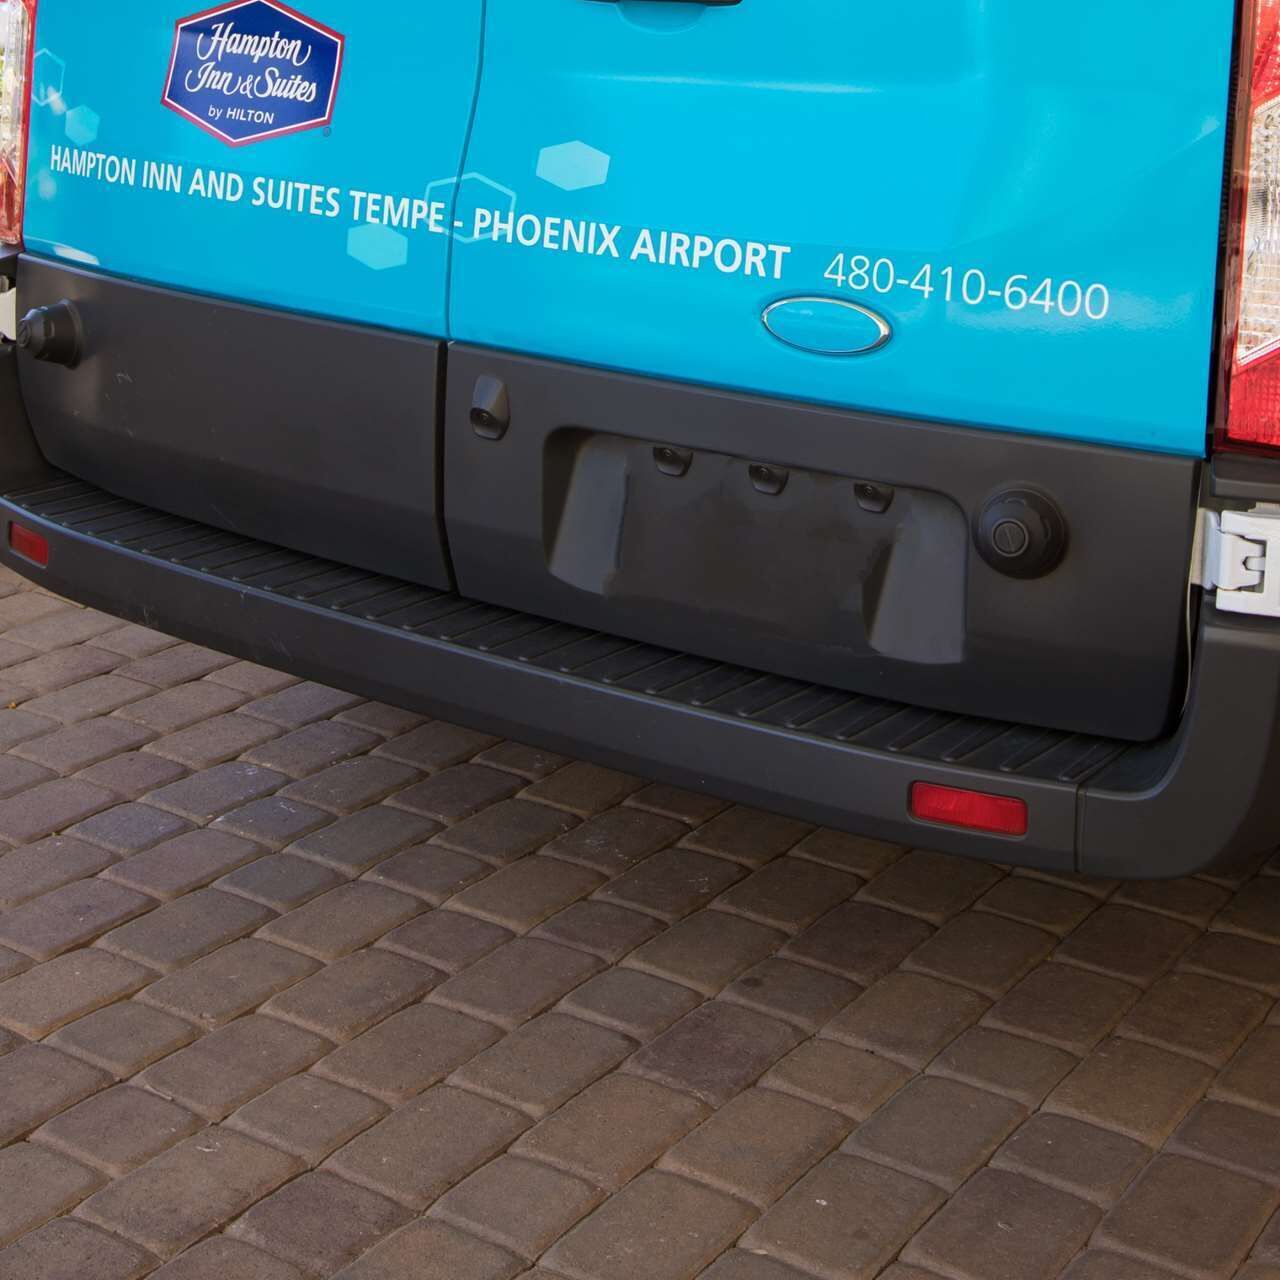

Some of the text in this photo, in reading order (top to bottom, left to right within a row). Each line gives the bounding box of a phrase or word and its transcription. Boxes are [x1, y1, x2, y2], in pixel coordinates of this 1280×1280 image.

[196, 22, 312, 66] Hampton
[185, 62, 317, 103] Inn & Suites
[208, 104, 275, 125] by HILTON
[50, 144, 137, 187] HAMPTON
[142, 160, 183, 193] INN
[188, 168, 244, 202] AND
[251, 176, 341, 218] SUITES
[348, 189, 445, 234] TEMPE
[473, 207, 622, 258] PHOENIX
[629, 228, 792, 280] AIRPORT
[822, 251, 1112, 321] 480-410-6400
